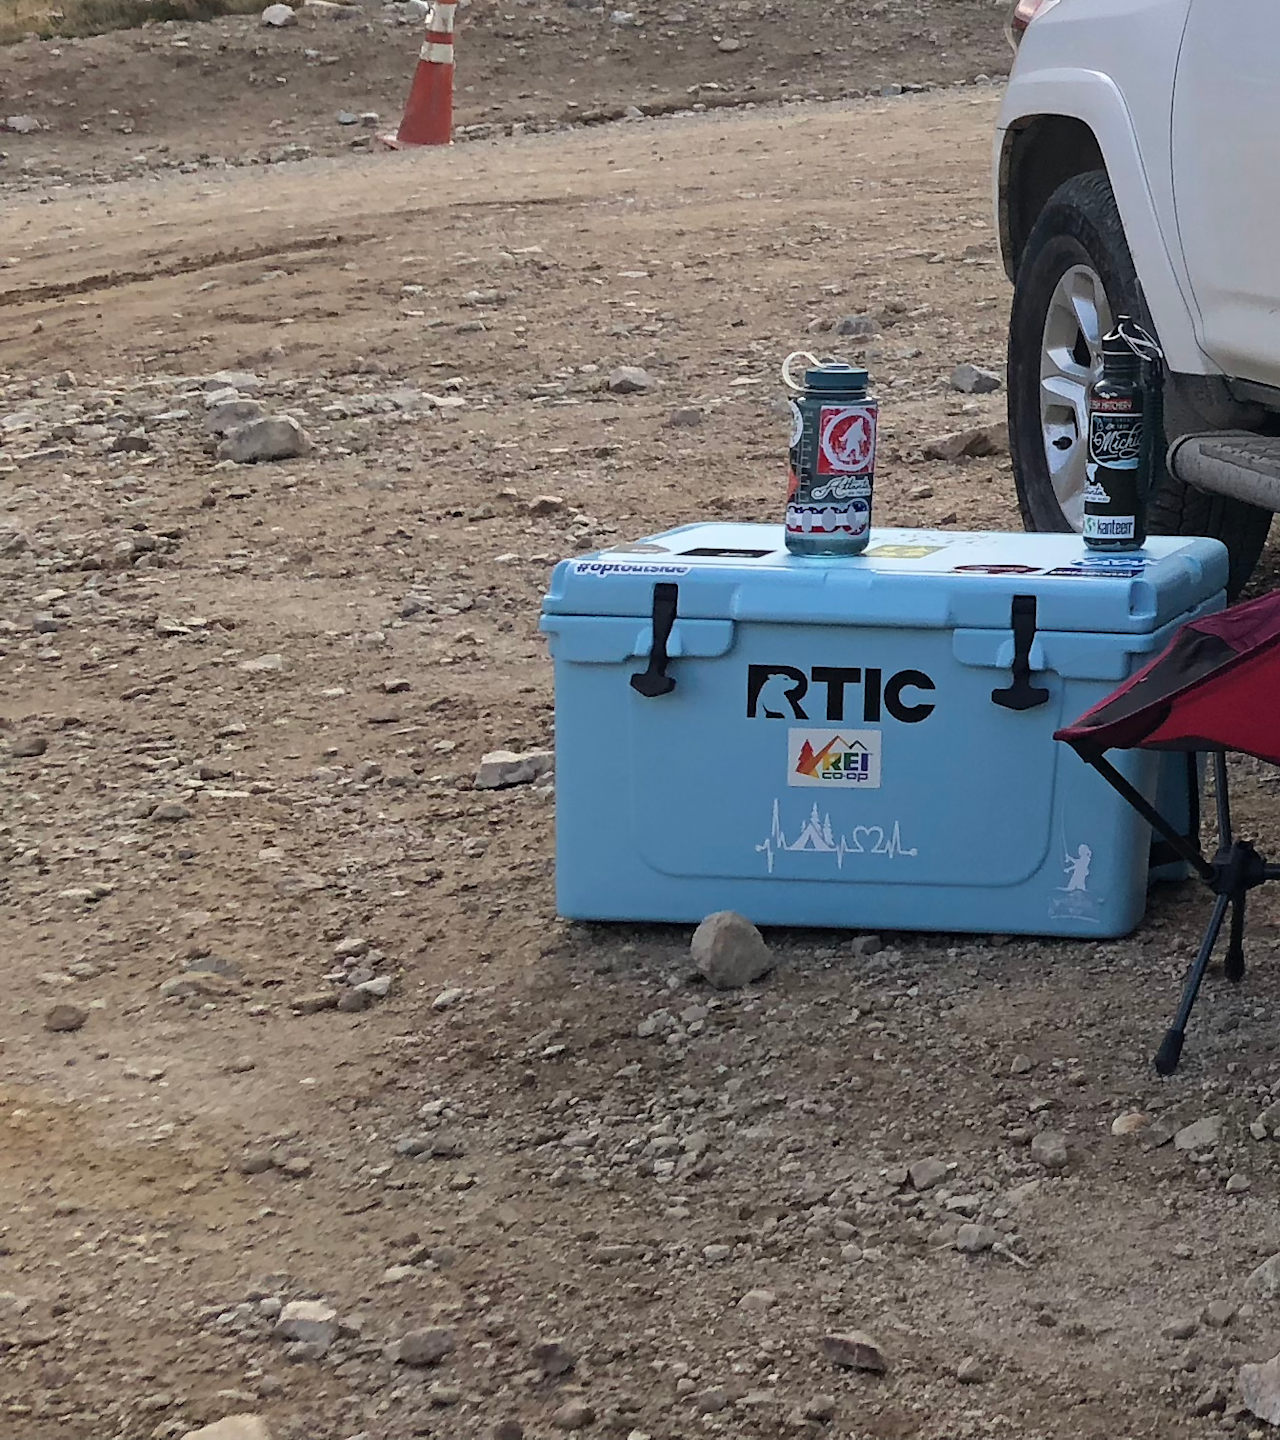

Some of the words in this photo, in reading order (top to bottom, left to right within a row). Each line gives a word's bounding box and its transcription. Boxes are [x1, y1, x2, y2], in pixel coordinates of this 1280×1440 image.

[747, 664, 936, 723] RTIC
[822, 752, 869, 772] REI
[822, 772, 868, 783] co-op
